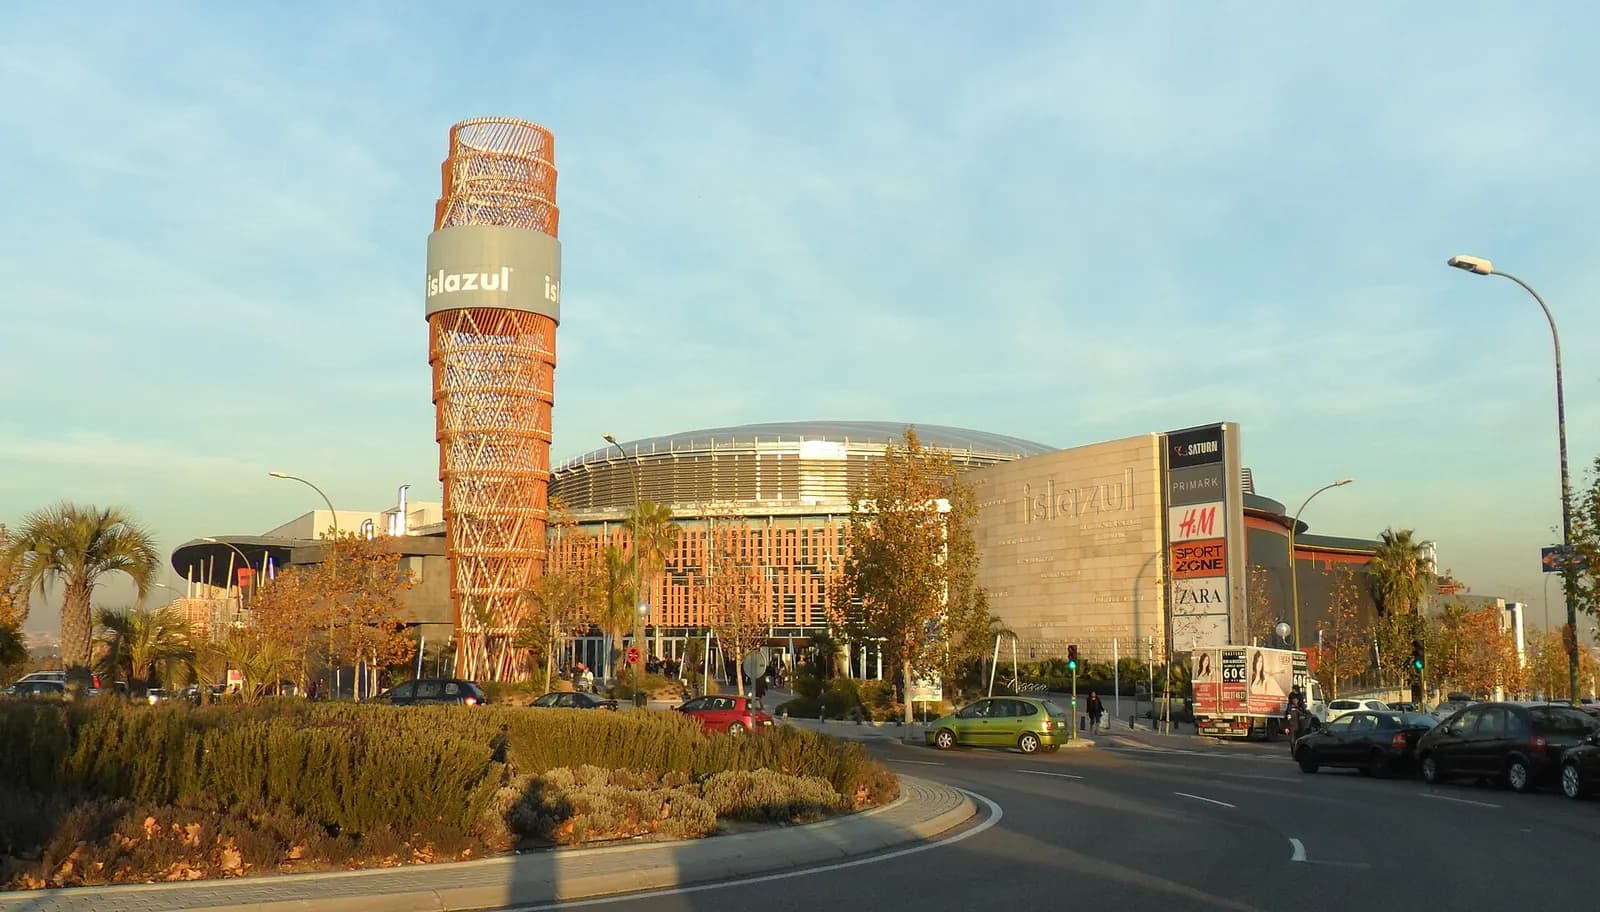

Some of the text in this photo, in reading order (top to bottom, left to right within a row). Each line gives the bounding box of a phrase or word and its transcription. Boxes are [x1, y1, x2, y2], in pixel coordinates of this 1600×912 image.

[427, 266, 509, 297] islazul
[1187, 440, 1218, 457] SATURN
[1172, 476, 1219, 493] PRIMARK
[1022, 466, 1136, 526] islazul
[1179, 506, 1216, 538] H&M
[1175, 545, 1223, 560] SPORT
[1175, 558, 1224, 573] ZONE
[1178, 589, 1222, 606] ZARA
